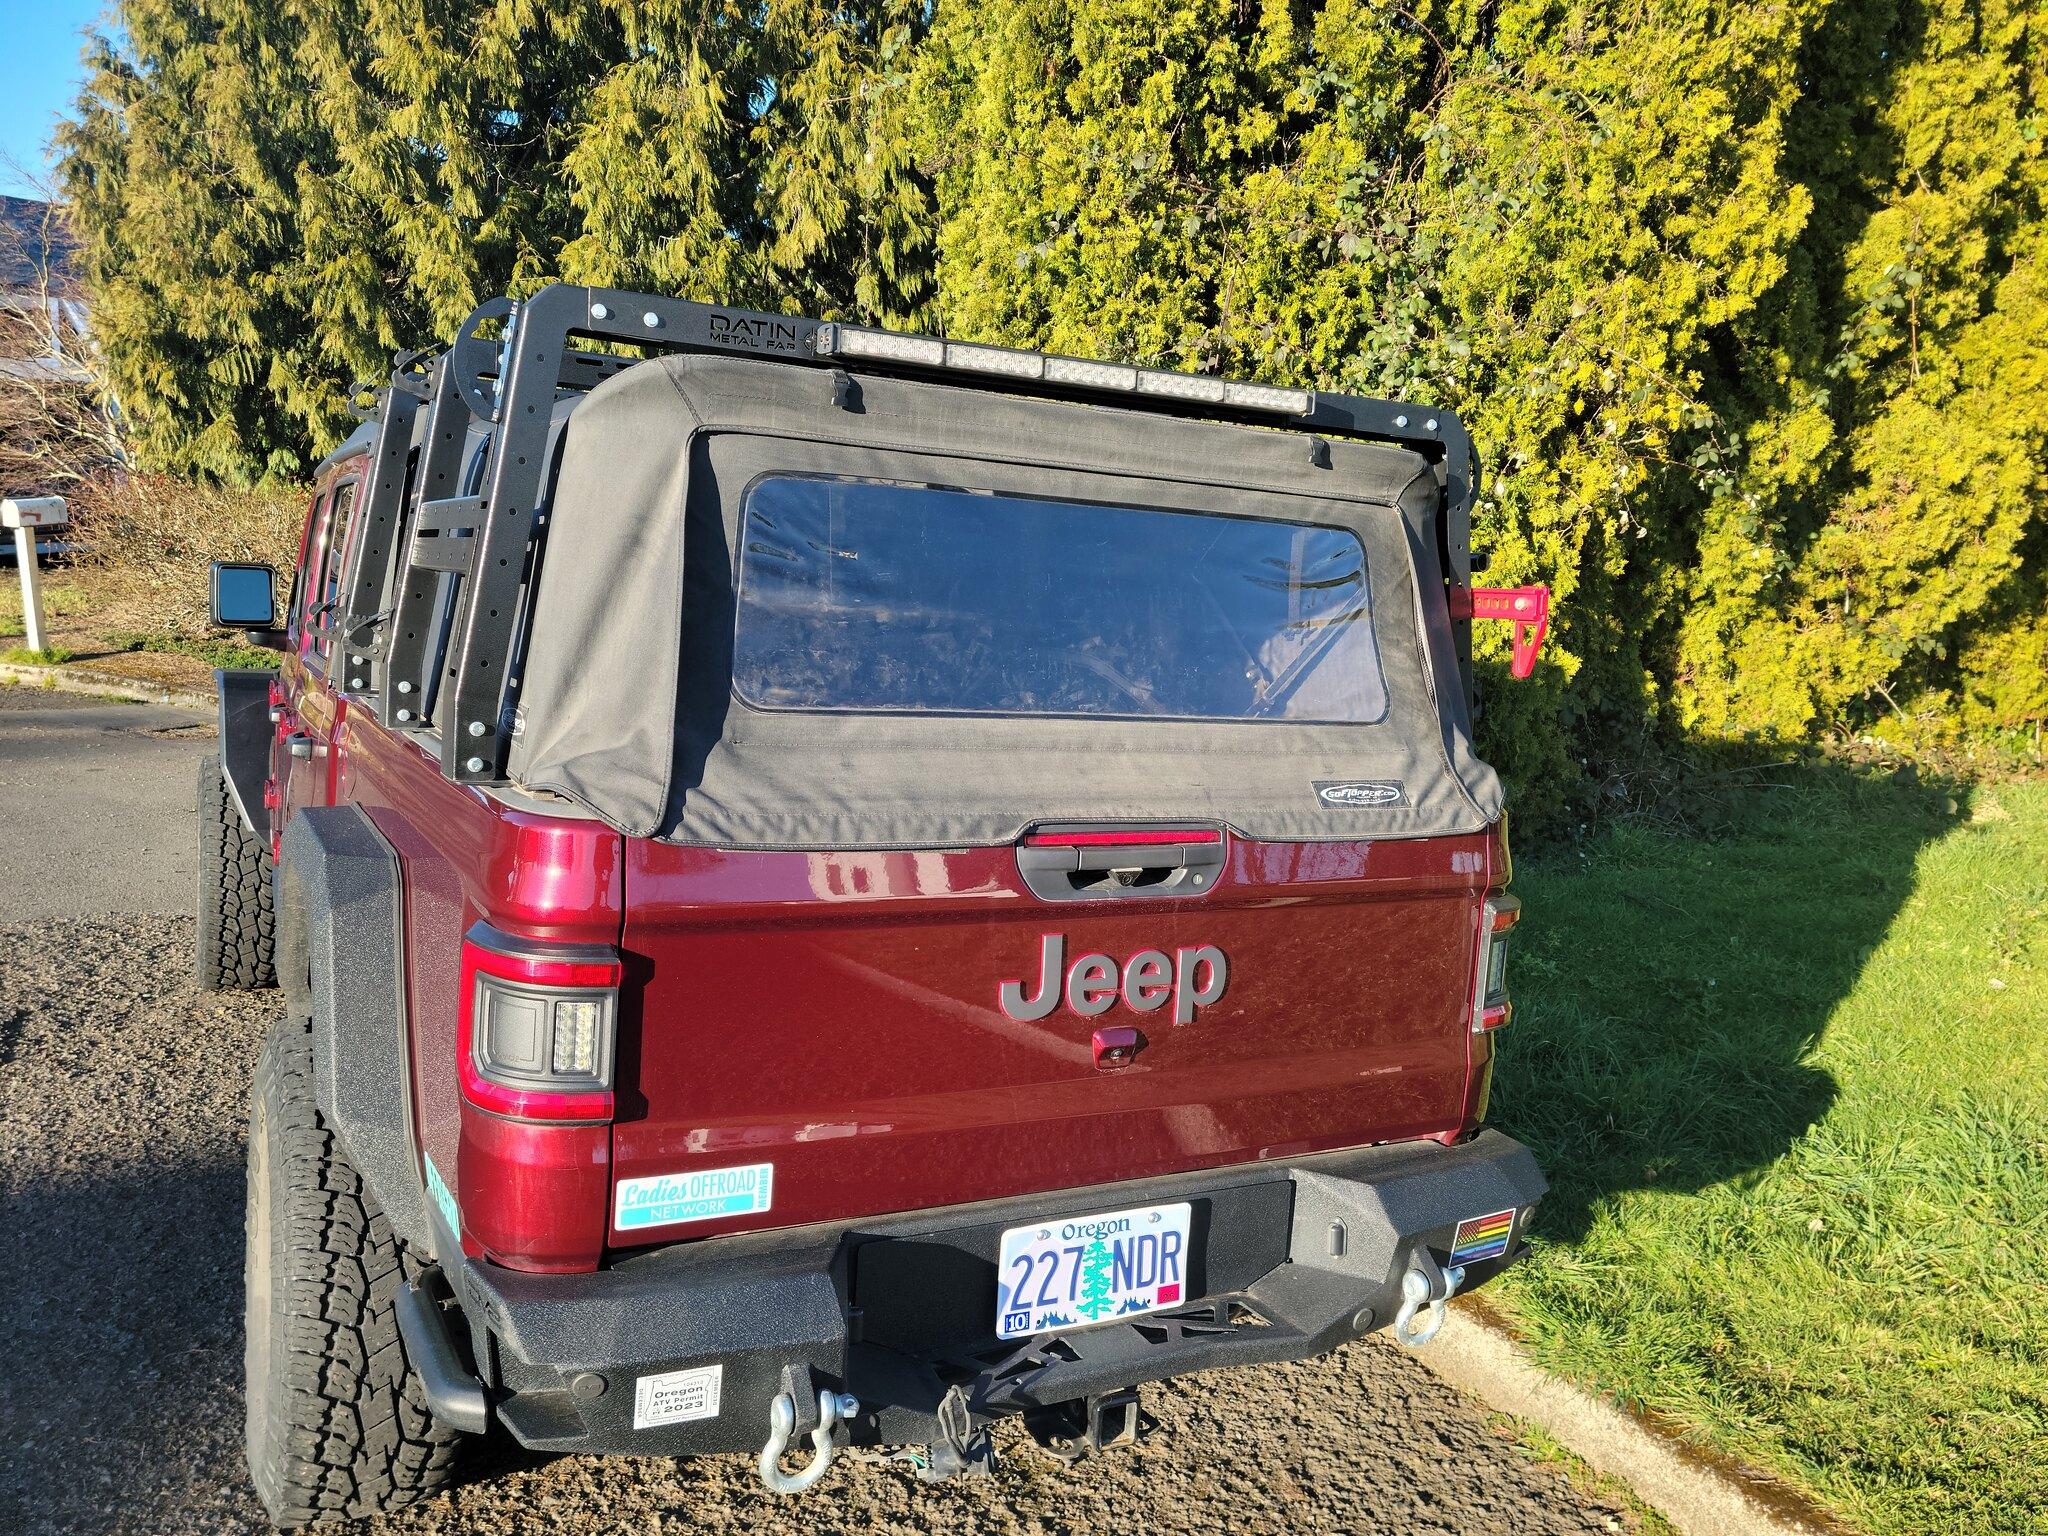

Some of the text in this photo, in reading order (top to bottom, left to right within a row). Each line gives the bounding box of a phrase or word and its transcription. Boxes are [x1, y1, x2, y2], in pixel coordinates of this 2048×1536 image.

[710, 314, 796, 341] DATIN
[710, 333, 759, 347] METAL
[1000, 933, 1229, 1025] Jeep
[622, 1169, 757, 1207] Ladies OFFROAD
[758, 1168, 769, 1209] MEMBER
[651, 1199, 727, 1222] NETWORK
[1061, 1217, 1131, 1241] Oregon
[1010, 1230, 1182, 1312] 227 NDR
[1008, 1313, 1026, 1331] 10
[653, 1394, 703, 1407] ATV Permit
[654, 1386, 703, 1399] Oregon
[664, 1401, 703, 1413] 2023
